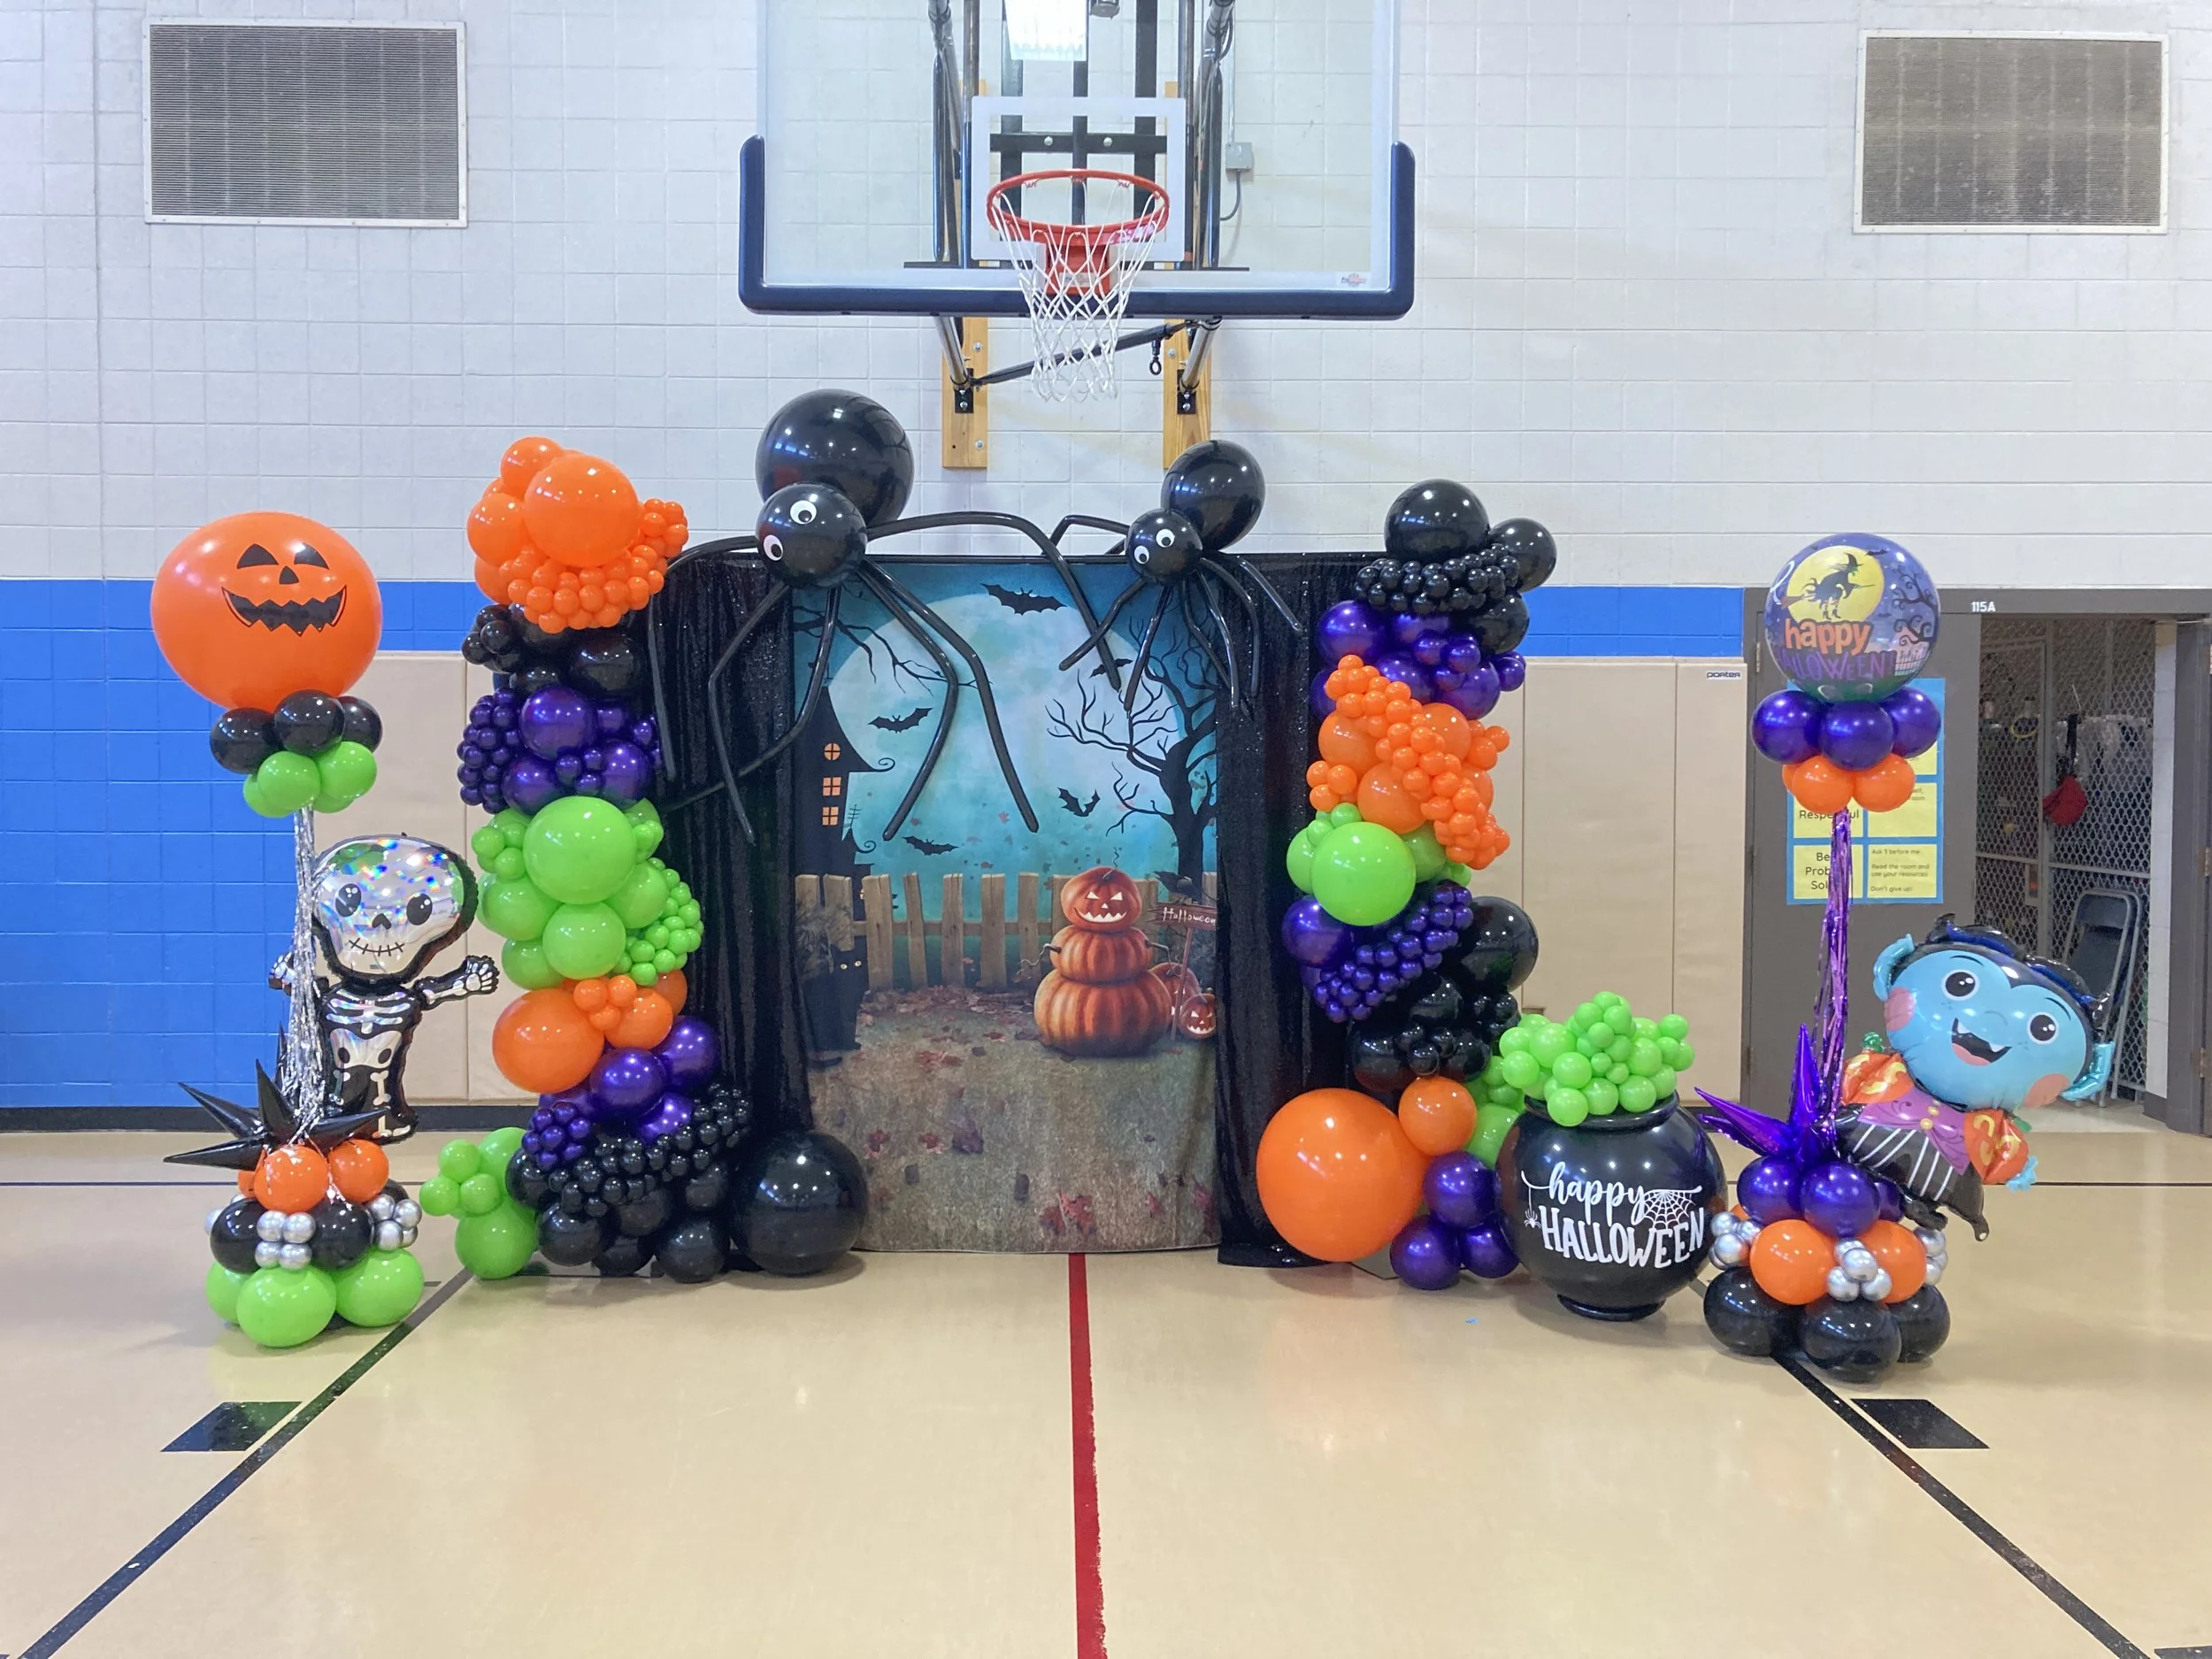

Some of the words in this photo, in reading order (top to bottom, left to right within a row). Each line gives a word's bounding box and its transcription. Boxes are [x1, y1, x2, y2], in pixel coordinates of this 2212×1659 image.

[1971, 601, 1996, 612] 115A
[1785, 618, 1871, 656] happy
[1799, 810, 1859, 820] Respeul
[1816, 852, 1831, 862] Be
[1163, 907, 1216, 926] Halloween
[1548, 1161, 1653, 1226] happy
[1538, 1205, 1704, 1269] HALLOWEEN
